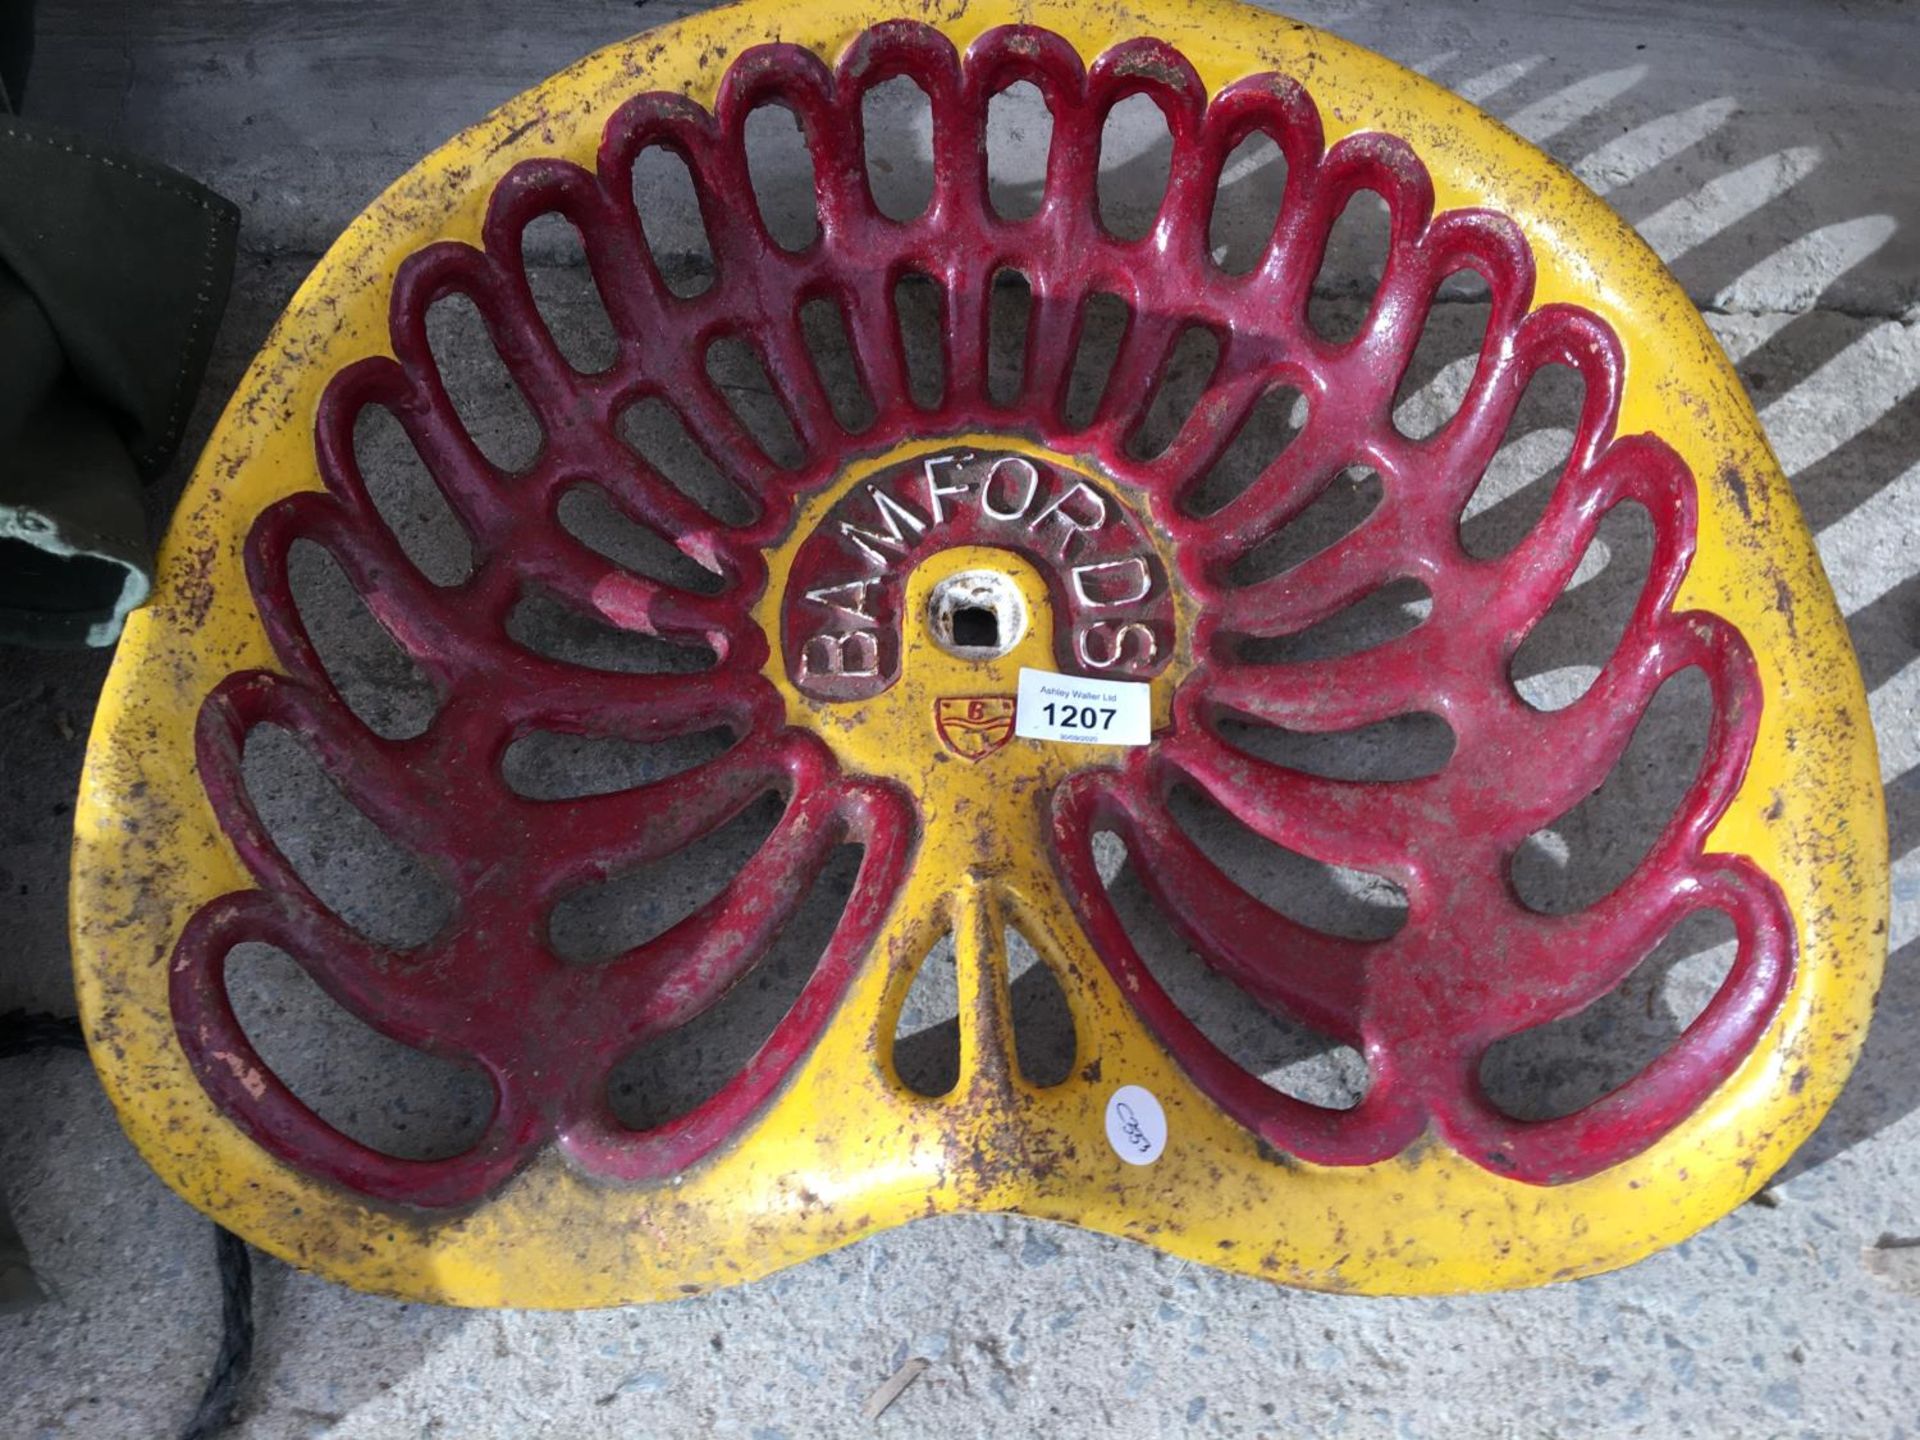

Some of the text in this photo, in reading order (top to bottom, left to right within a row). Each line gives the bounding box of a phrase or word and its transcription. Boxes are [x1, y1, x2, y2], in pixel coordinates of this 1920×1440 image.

[800, 453, 1156, 683] BAMFORDS
[1040, 686, 1117, 702] Ashley Waller Ltd
[1043, 703, 1117, 730] 1207
